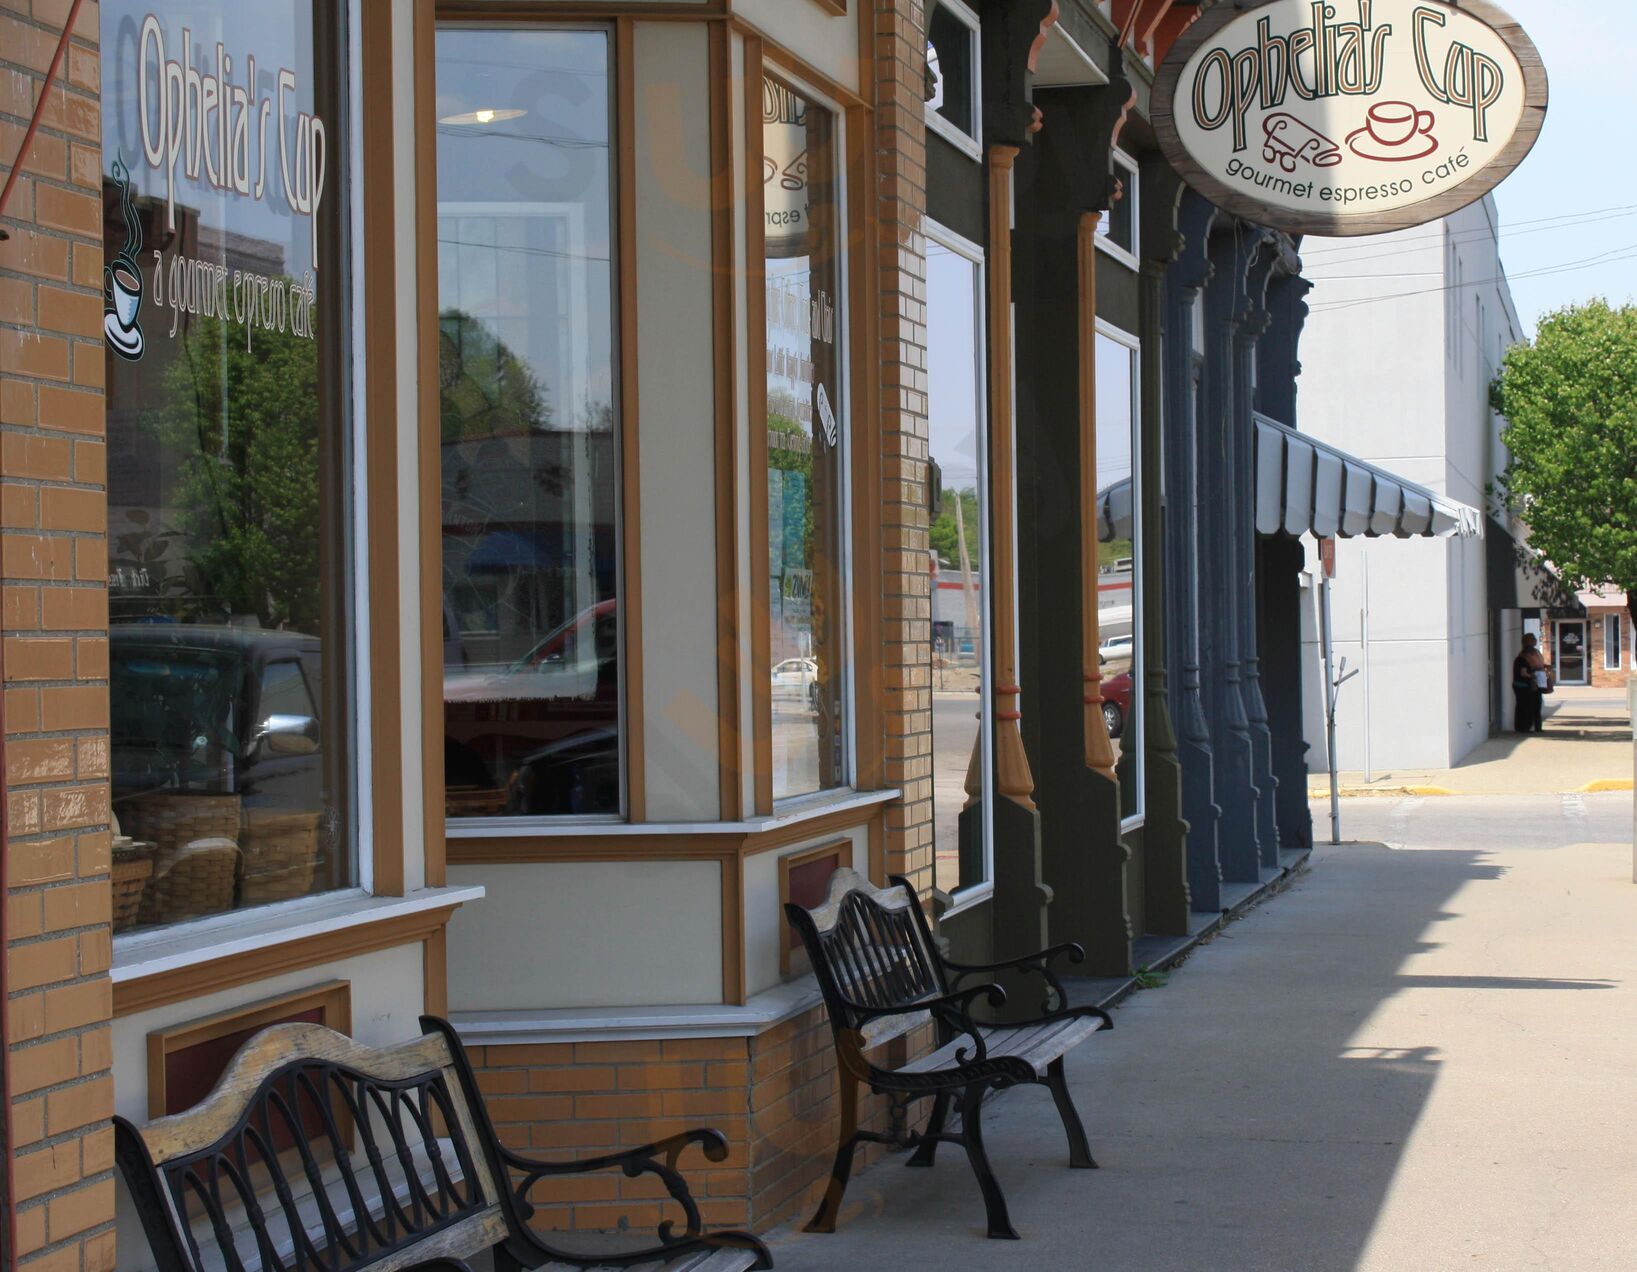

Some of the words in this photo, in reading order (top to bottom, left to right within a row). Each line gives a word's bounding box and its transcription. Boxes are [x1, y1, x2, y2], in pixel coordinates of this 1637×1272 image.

[1192, 0, 1392, 152] Ophelia's
[1413, 6, 1504, 142] Cup
[139, 13, 270, 234] Ophelia's
[279, 68, 326, 271] Cup
[1225, 158, 1314, 199] gourmet
[1319, 179, 1412, 205] espresso
[1421, 146, 1470, 184] café
[153, 250, 164, 307] a
[168, 253, 230, 338] gourmet
